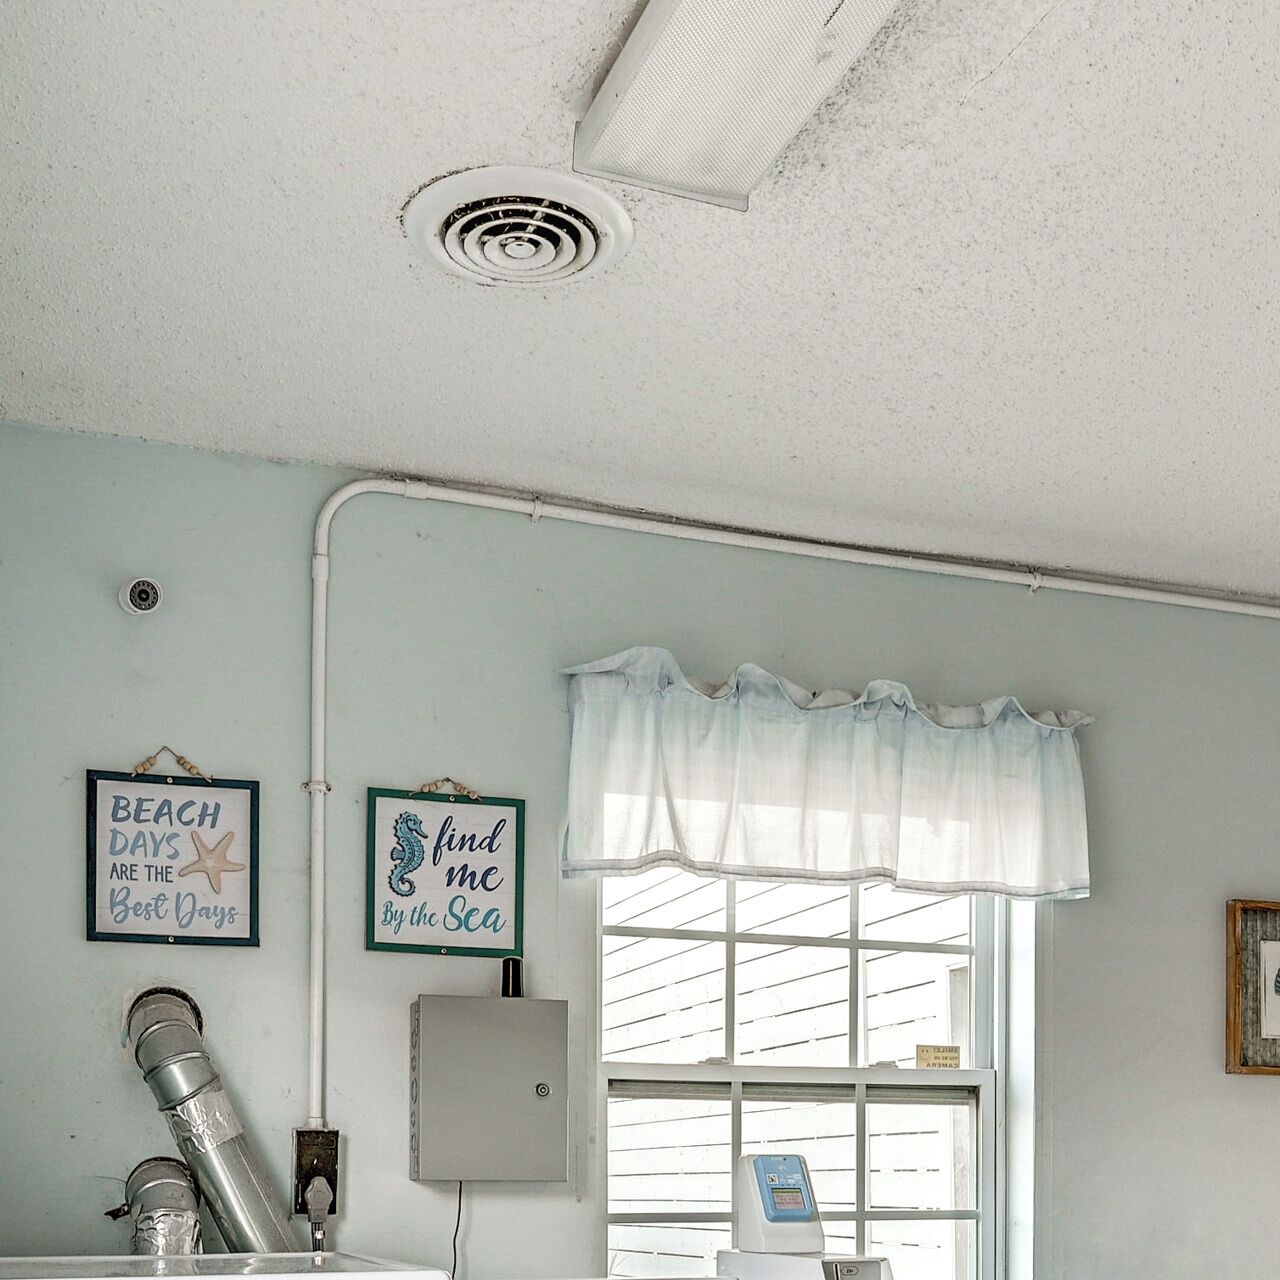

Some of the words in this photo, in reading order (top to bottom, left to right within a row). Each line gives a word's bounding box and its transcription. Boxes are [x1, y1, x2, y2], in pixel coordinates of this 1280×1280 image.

[111, 795, 220, 829] BEACH
[109, 829, 180, 860] DAYS
[432, 816, 507, 865] find
[110, 864, 138, 882] ARE
[145, 865, 174, 883] THE
[445, 863, 505, 891] me
[109, 887, 168, 924] Best
[175, 893, 239, 929] Days
[409, 901, 438, 927] the
[442, 895, 506, 934] Sea
